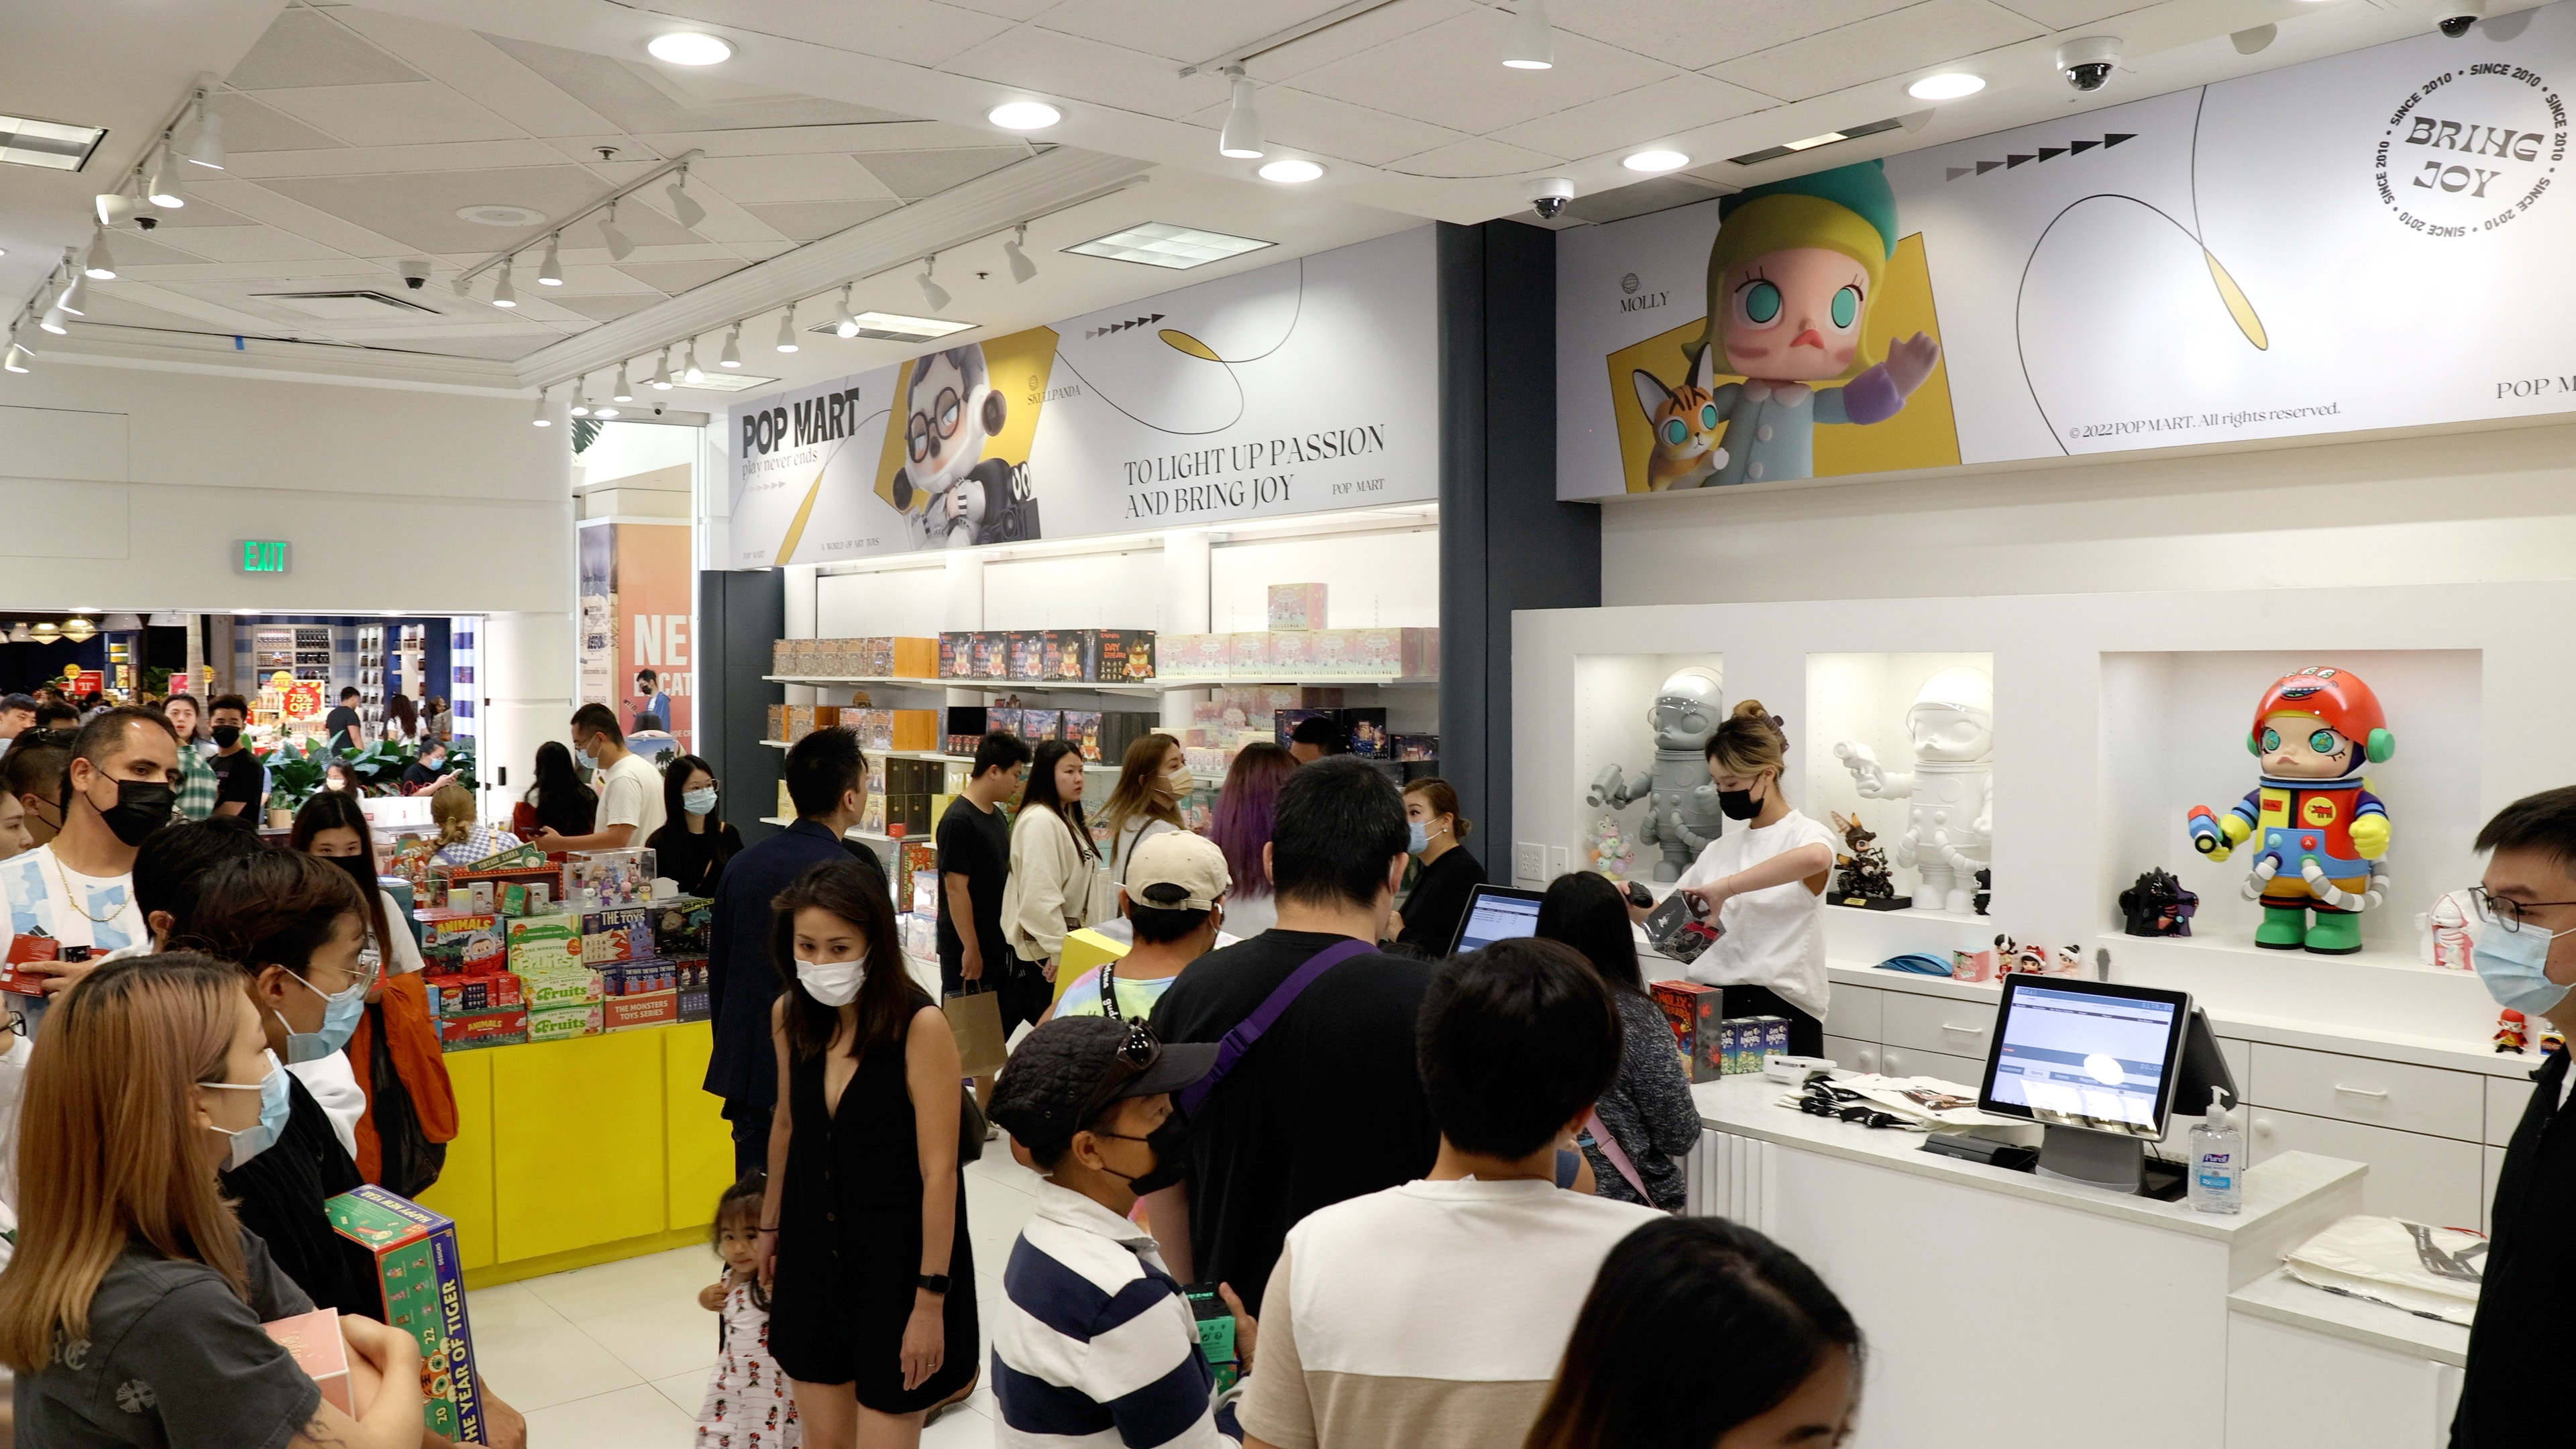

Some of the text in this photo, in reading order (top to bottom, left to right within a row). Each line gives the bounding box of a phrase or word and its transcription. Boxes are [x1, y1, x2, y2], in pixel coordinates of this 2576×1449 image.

[2470, 63, 2542, 87] SINCE 2010
[2390, 72, 2453, 126] SINCE 2010
[2405, 116, 2544, 162] BRING
[2545, 94, 2567, 162] SINCE 2010
[2375, 141, 2395, 205] SINCE 2010
[2413, 161, 2502, 198] JOY
[2485, 177, 2551, 231] SINCE 2010
[2399, 212, 2466, 237] SINCE 2010
[1621, 291, 1670, 313] MOLLY
[1027, 384, 1081, 405] SKULLPANDA
[2496, 375, 2576, 399] POP M
[743, 387, 859, 459] POP MART
[2083, 423, 2112, 438] 2022
[2115, 421, 2145, 435] POP
[2148, 415, 2196, 432] MART.
[2198, 414, 2218, 427] All
[2222, 411, 2266, 428] rights
[2269, 402, 2341, 421] reserved.
[742, 447, 818, 480] play never ends
[1124, 424, 1385, 486] TO LIGHT UP PASSION
[1125, 474, 1295, 519] AND BRING JOY
[1333, 478, 1385, 495] POP MART
[244, 541, 286, 572] EXIT
[634, 614, 692, 666] NE
[634, 672, 692, 697] LCAT
[289, 694, 314, 703] 75%
[289, 703, 314, 712] OFF
[436, 918, 492, 934] ANIMALS
[600, 911, 620, 925] THE
[621, 913, 645, 924] TOYS
[537, 986, 587, 1000] Fruits
[614, 1000, 668, 1013] THE MONSTERS
[620, 1008, 663, 1020] TOYS SERIES
[468, 1020, 502, 1031] ANIMALS
[535, 1018, 586, 1034] Fruits
[360, 1191, 433, 1224] HAPPY NEW YEAR
[435, 1242, 444, 1266] DESIGNS
[442, 1278, 480, 1444] HE YEAR OF TIGER
[423, 1327, 447, 1425] 20 22
